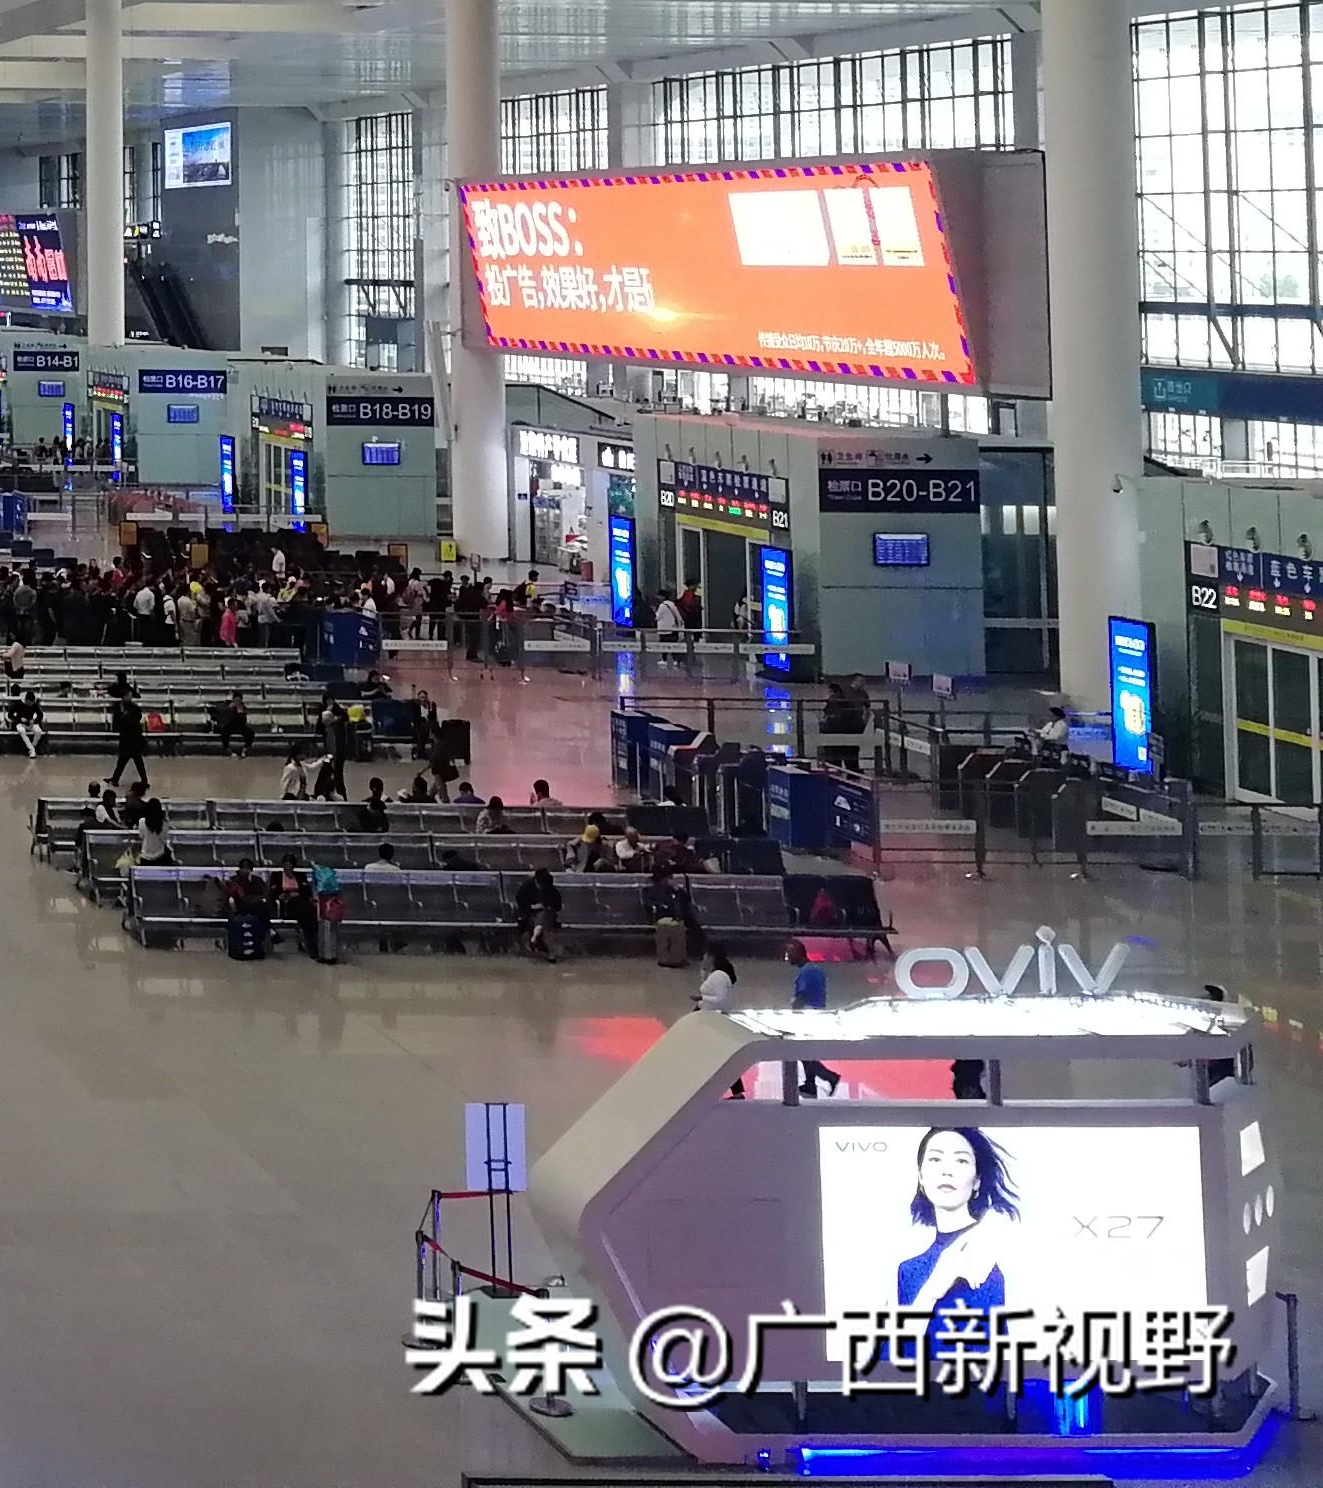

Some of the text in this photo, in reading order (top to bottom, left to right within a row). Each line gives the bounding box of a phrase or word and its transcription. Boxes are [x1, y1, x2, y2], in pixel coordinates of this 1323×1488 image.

[165, 375, 224, 389] B16-B17
[359, 403, 432, 420] B18-B19
[867, 479, 977, 503] B20-B21
[772, 509, 789, 529] B21
[1191, 585, 1218, 609] B22
[1072, 1215, 1165, 1240] X27
